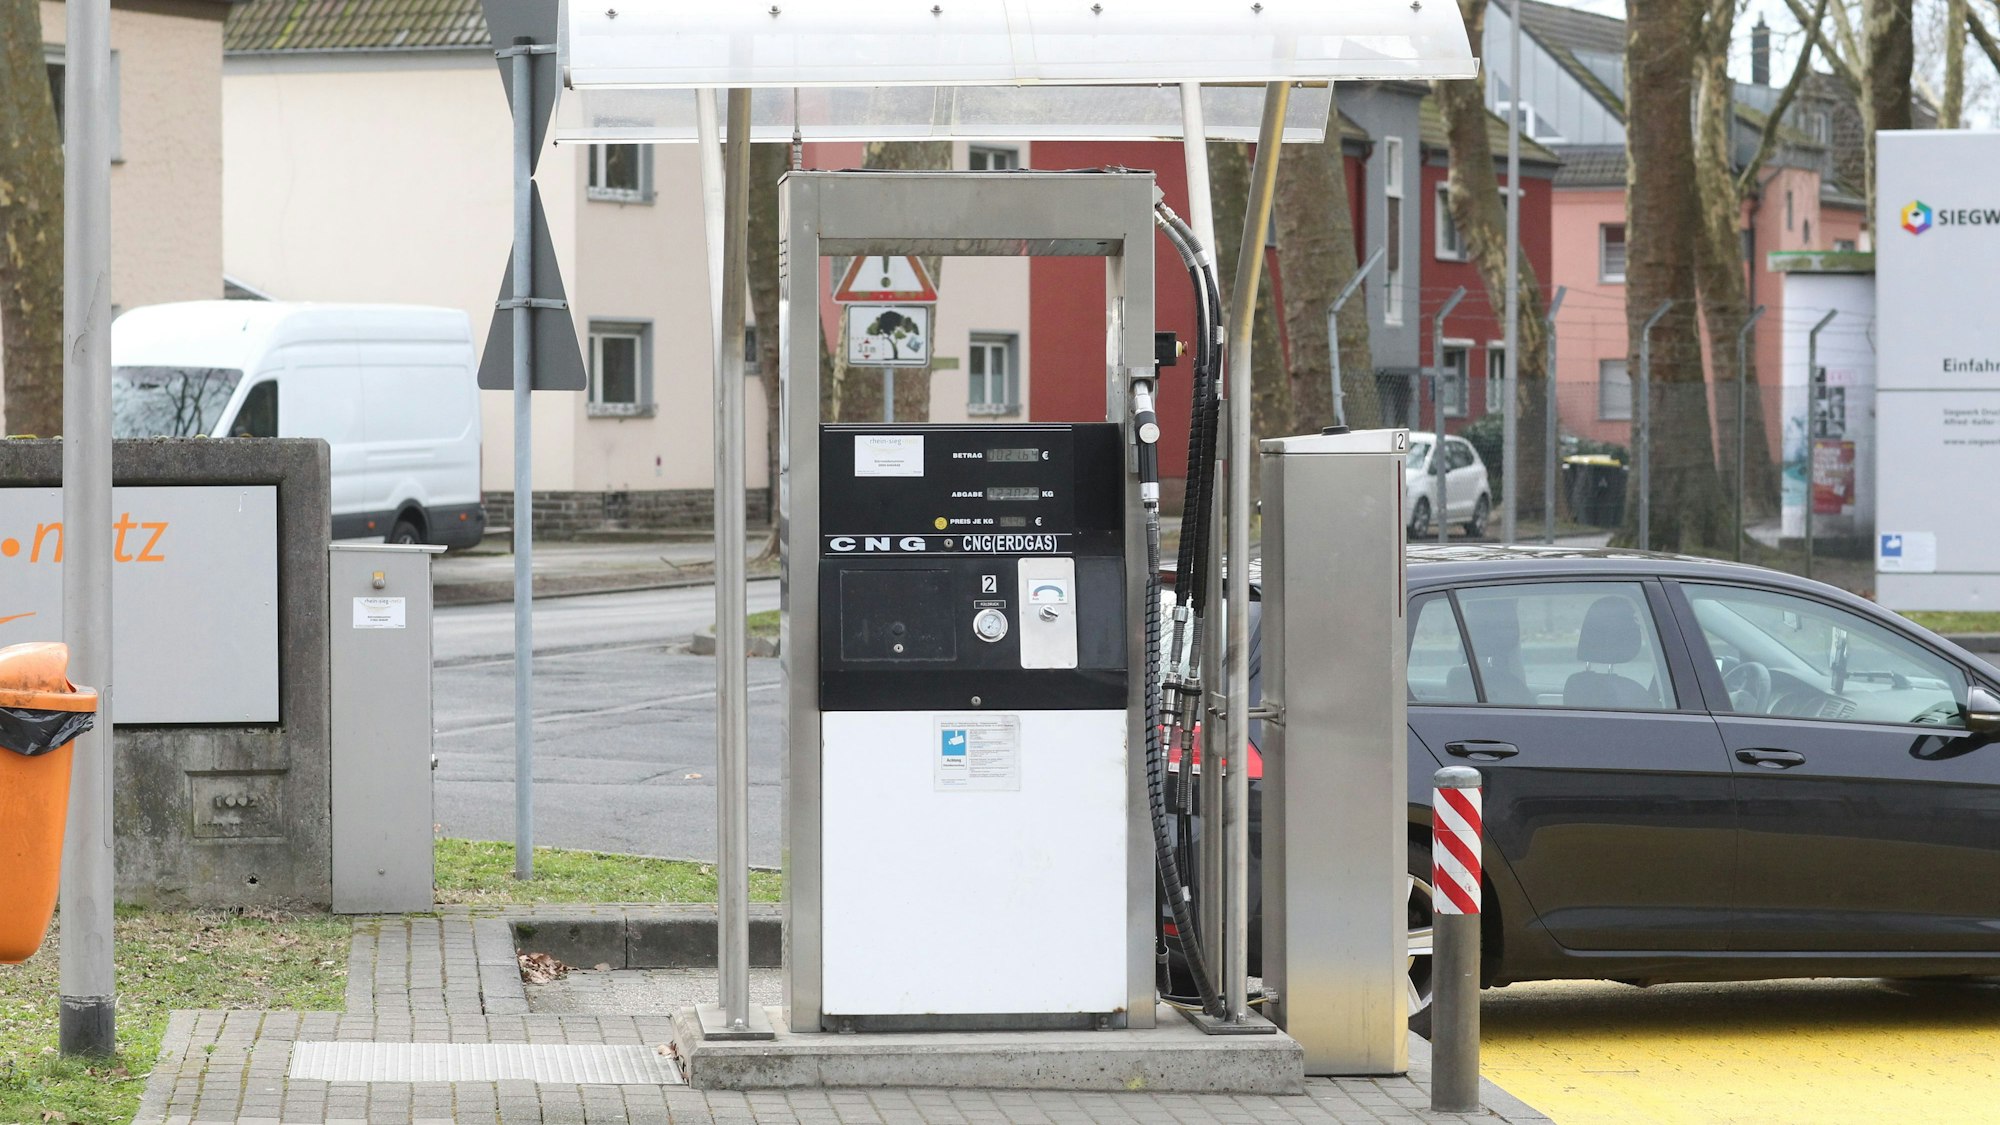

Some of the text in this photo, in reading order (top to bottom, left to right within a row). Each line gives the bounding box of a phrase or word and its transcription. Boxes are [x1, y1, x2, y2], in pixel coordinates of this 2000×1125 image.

[1397, 433, 1404, 450] 2
[1041, 450, 1049, 460] €
[1041, 490, 1054, 498] KG
[1034, 516, 1042, 526] €
[962, 535, 1058, 553] CNG(ERDGAS)
[984, 576, 995, 593] 2
